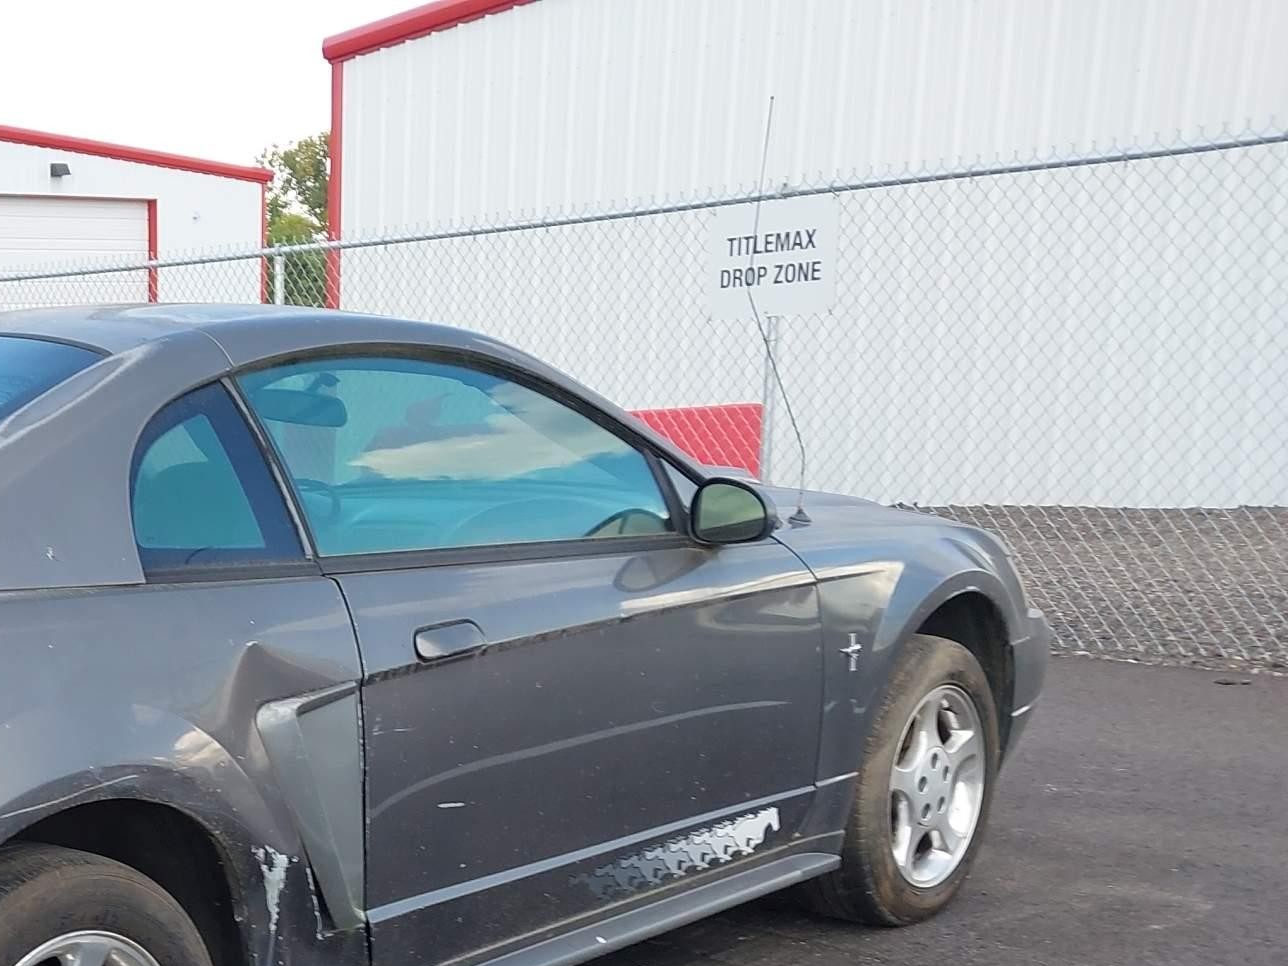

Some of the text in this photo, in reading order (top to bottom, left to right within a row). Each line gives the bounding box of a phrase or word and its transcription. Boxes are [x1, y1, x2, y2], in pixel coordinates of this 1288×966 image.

[727, 229, 817, 257] TITLEMAX
[720, 260, 822, 289] DROP ZONE
